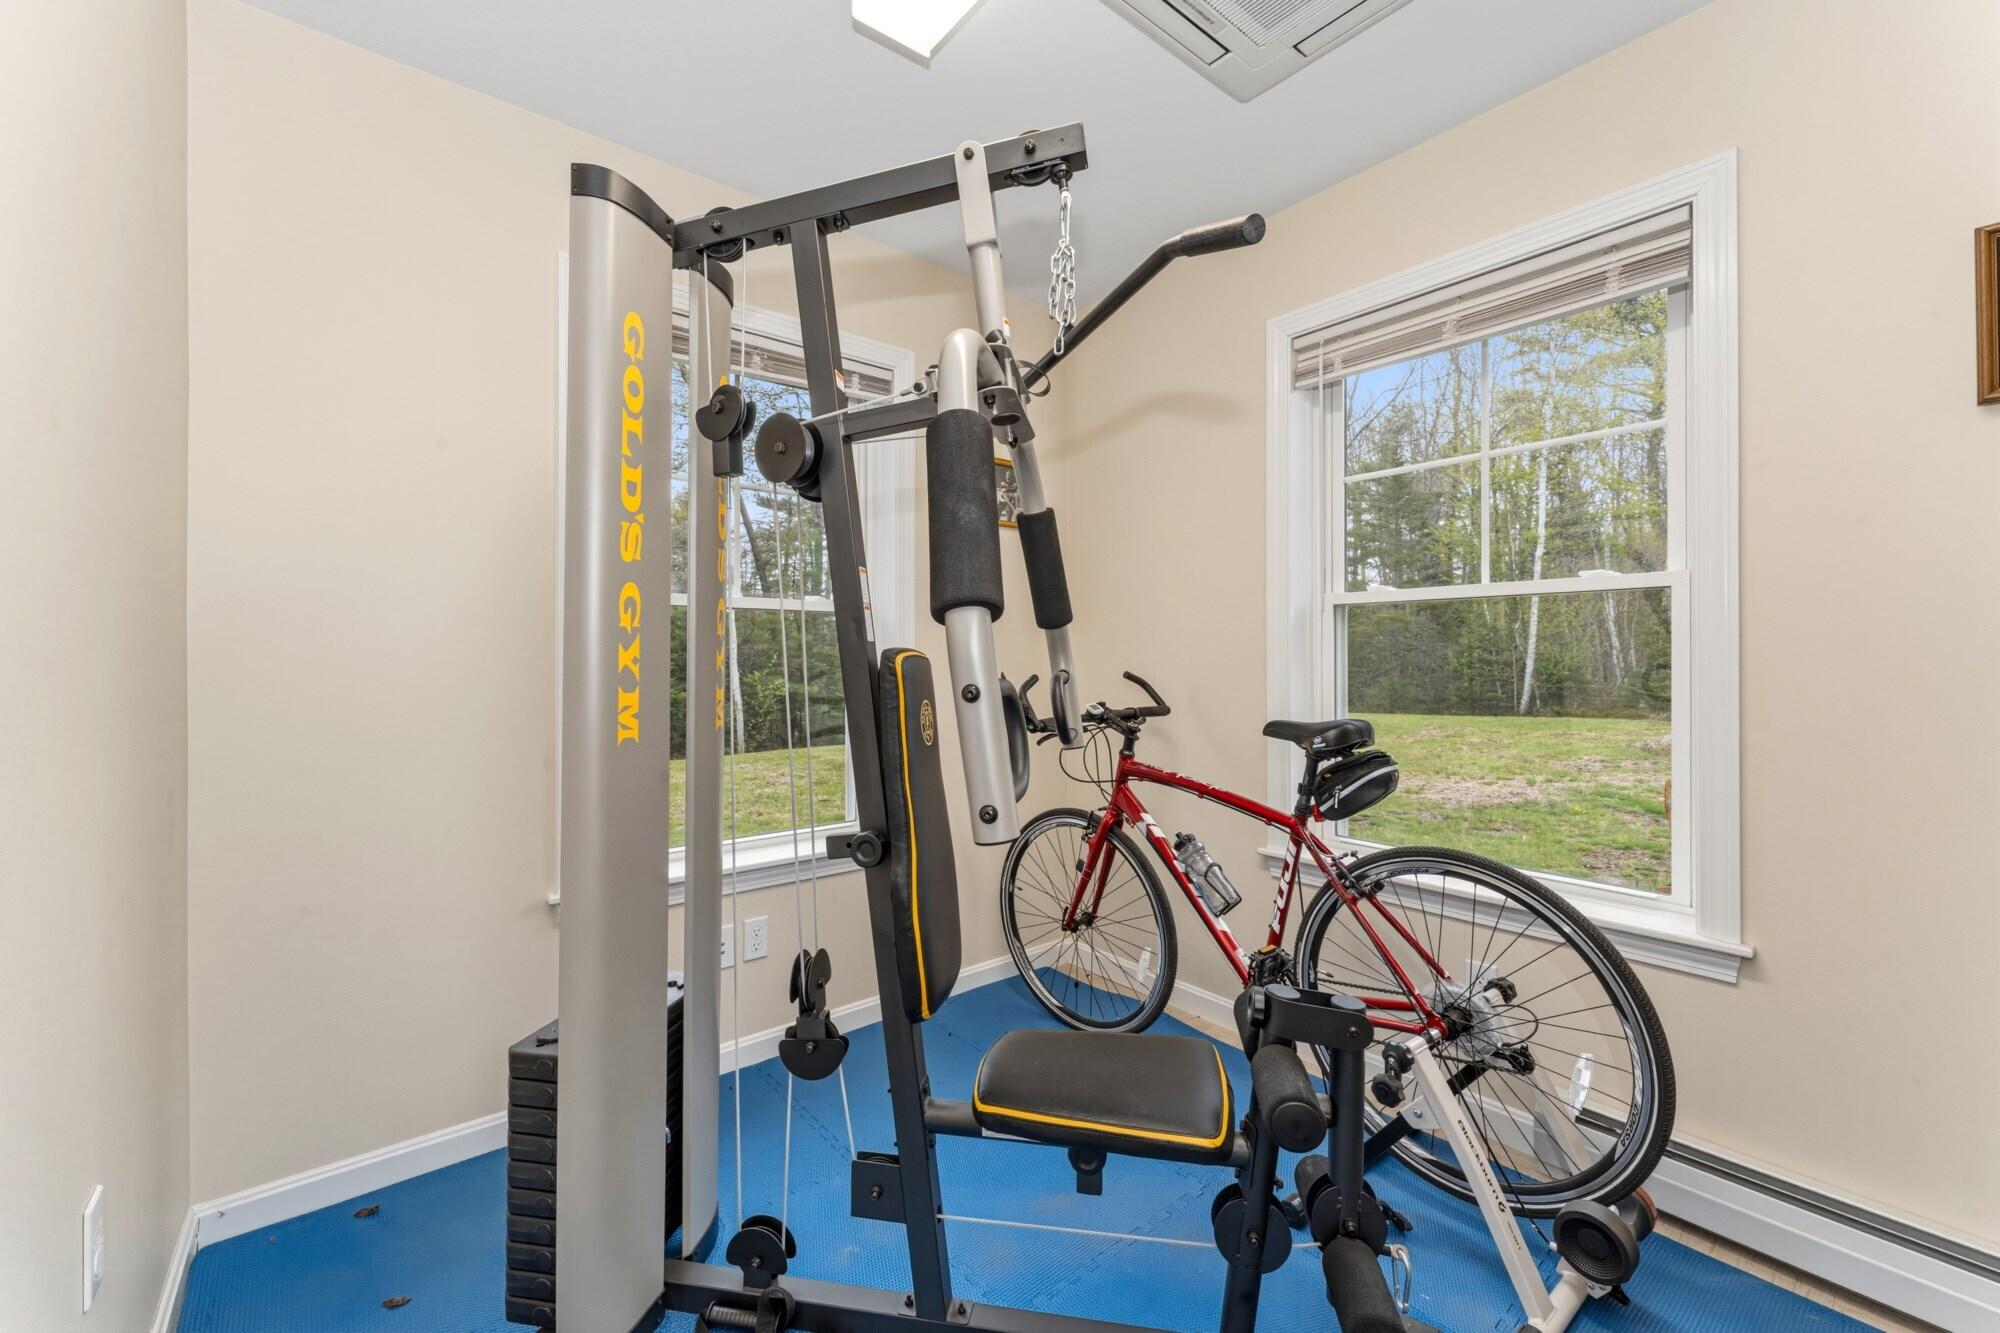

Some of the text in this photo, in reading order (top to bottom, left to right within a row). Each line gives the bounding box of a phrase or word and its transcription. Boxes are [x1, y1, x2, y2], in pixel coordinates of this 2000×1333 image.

[617, 311, 645, 747] GOLD'S GYM
[1271, 839, 1298, 935] FUJI
[1620, 1103, 1640, 1148] CORSA
